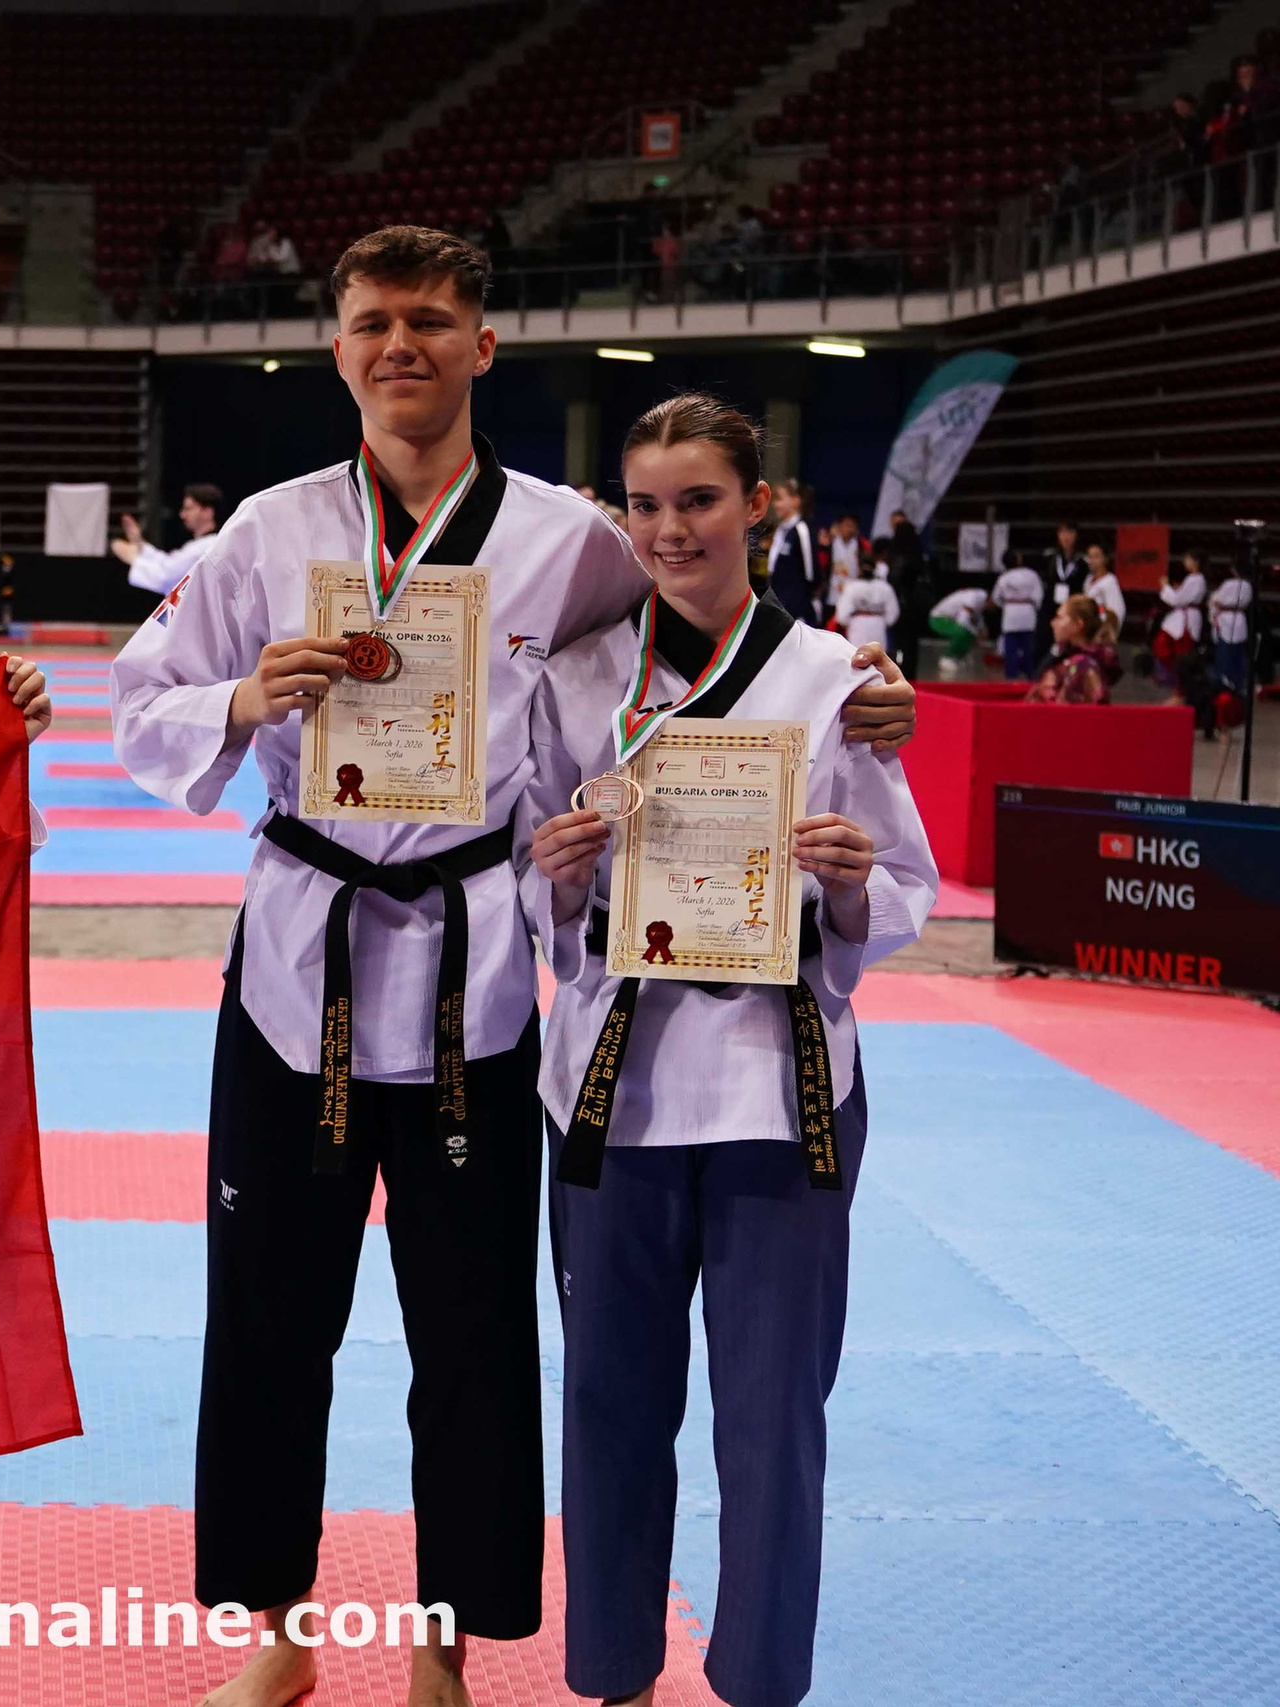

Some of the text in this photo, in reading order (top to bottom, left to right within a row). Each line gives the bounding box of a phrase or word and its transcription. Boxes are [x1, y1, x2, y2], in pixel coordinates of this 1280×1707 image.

[396, 632, 424, 641] OPEN
[426, 634, 452, 642] 2026
[366, 738, 393, 747] March
[404, 740, 423, 748] 2026
[385, 750, 403, 761] Sofia
[655, 786, 768, 798] BULGARIA OPEN 2026
[1143, 802, 1187, 816] JUNIOR
[1136, 836, 1201, 869] HKG
[677, 895, 704, 905] March
[716, 897, 736, 905] 2026
[1105, 876, 1196, 911] NG/NG
[695, 907, 715, 918] Sofia
[1074, 941, 1222, 988] WINNER
[333, 997, 349, 1144] CENTRAL TAEKWONDO
[451, 1048, 466, 1121] SELLWOOD
[807, 1001, 835, 1173] let your dreams just be dreams
